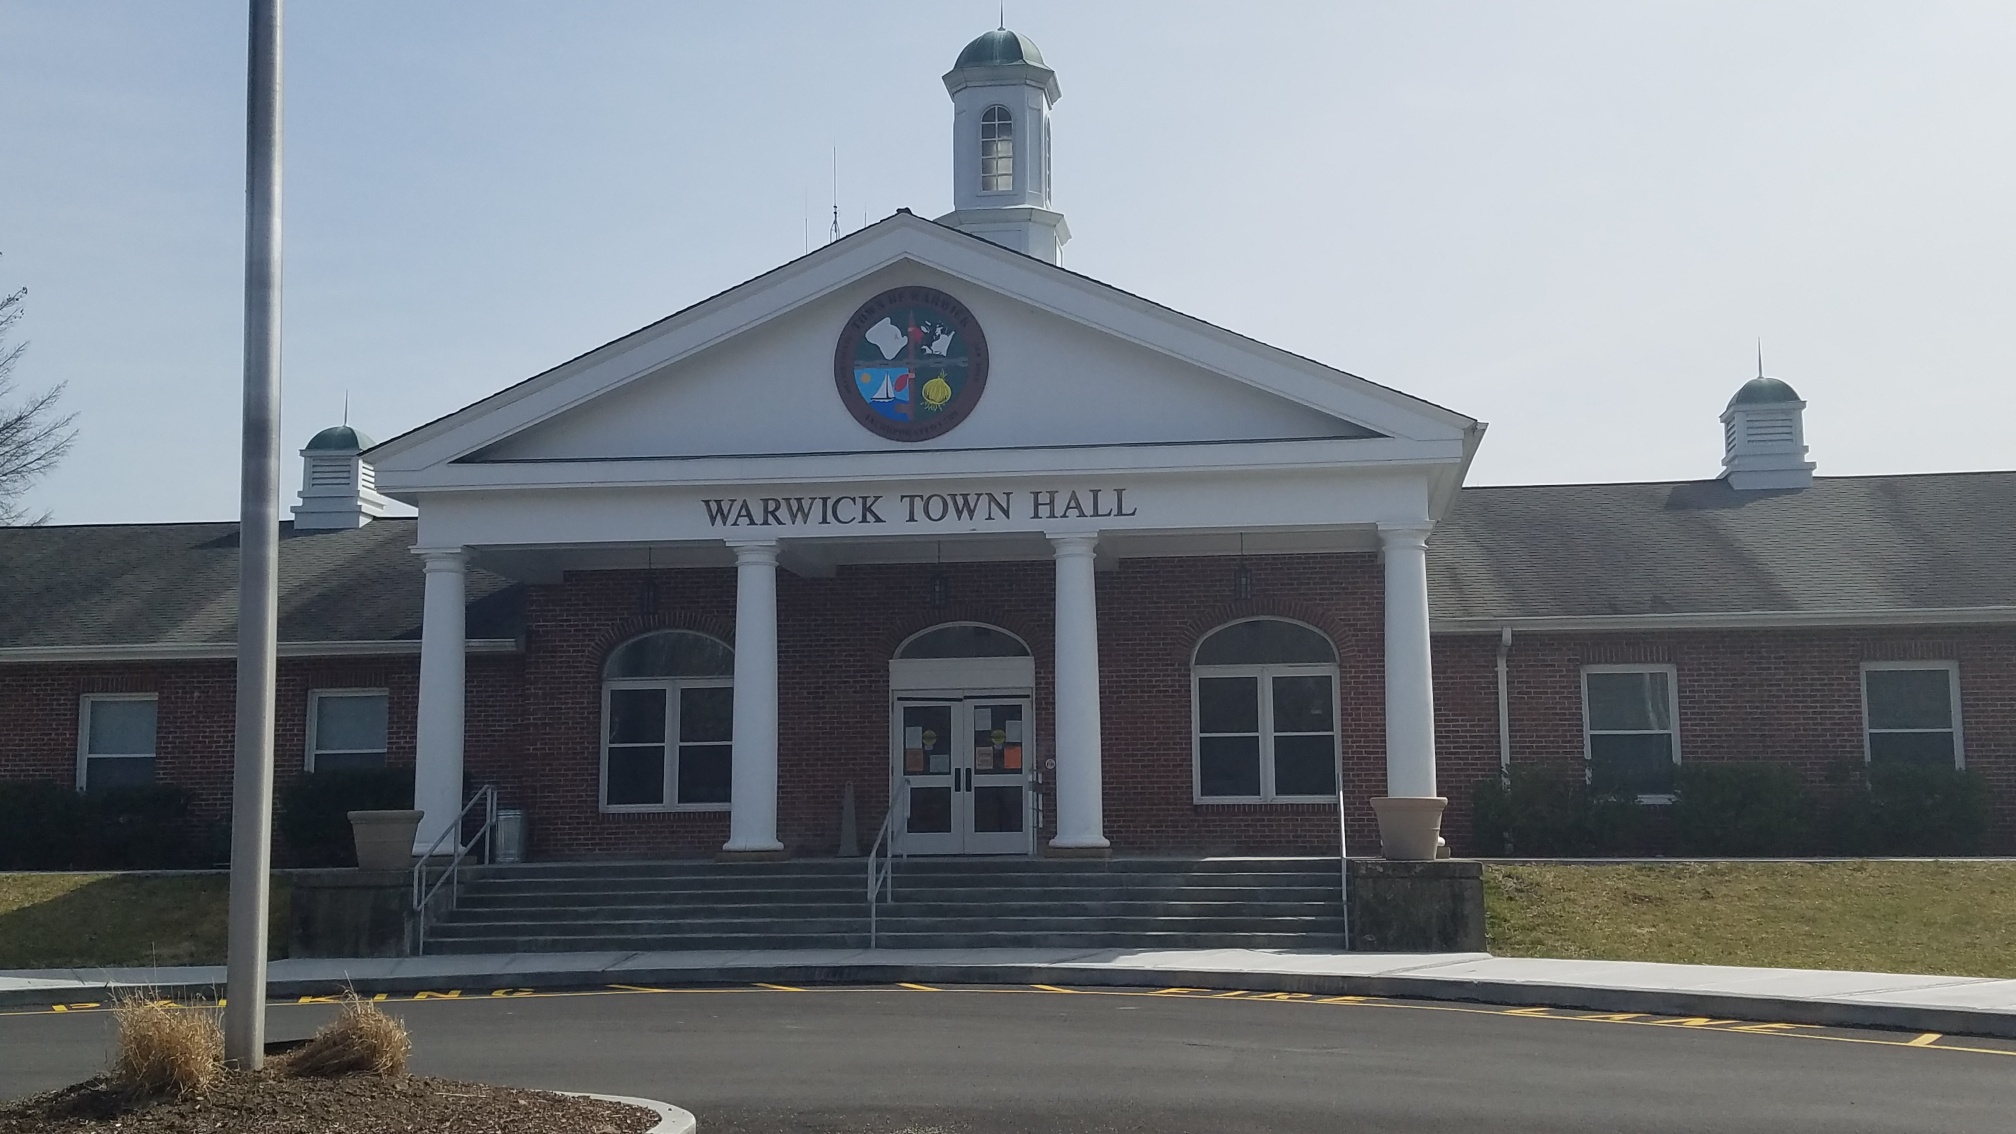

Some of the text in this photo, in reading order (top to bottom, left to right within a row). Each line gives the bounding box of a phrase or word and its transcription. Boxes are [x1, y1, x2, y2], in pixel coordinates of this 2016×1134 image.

[701, 488, 1138, 527] WARWICK TOWN HALL
[1146, 987, 1389, 1005] FIRE
